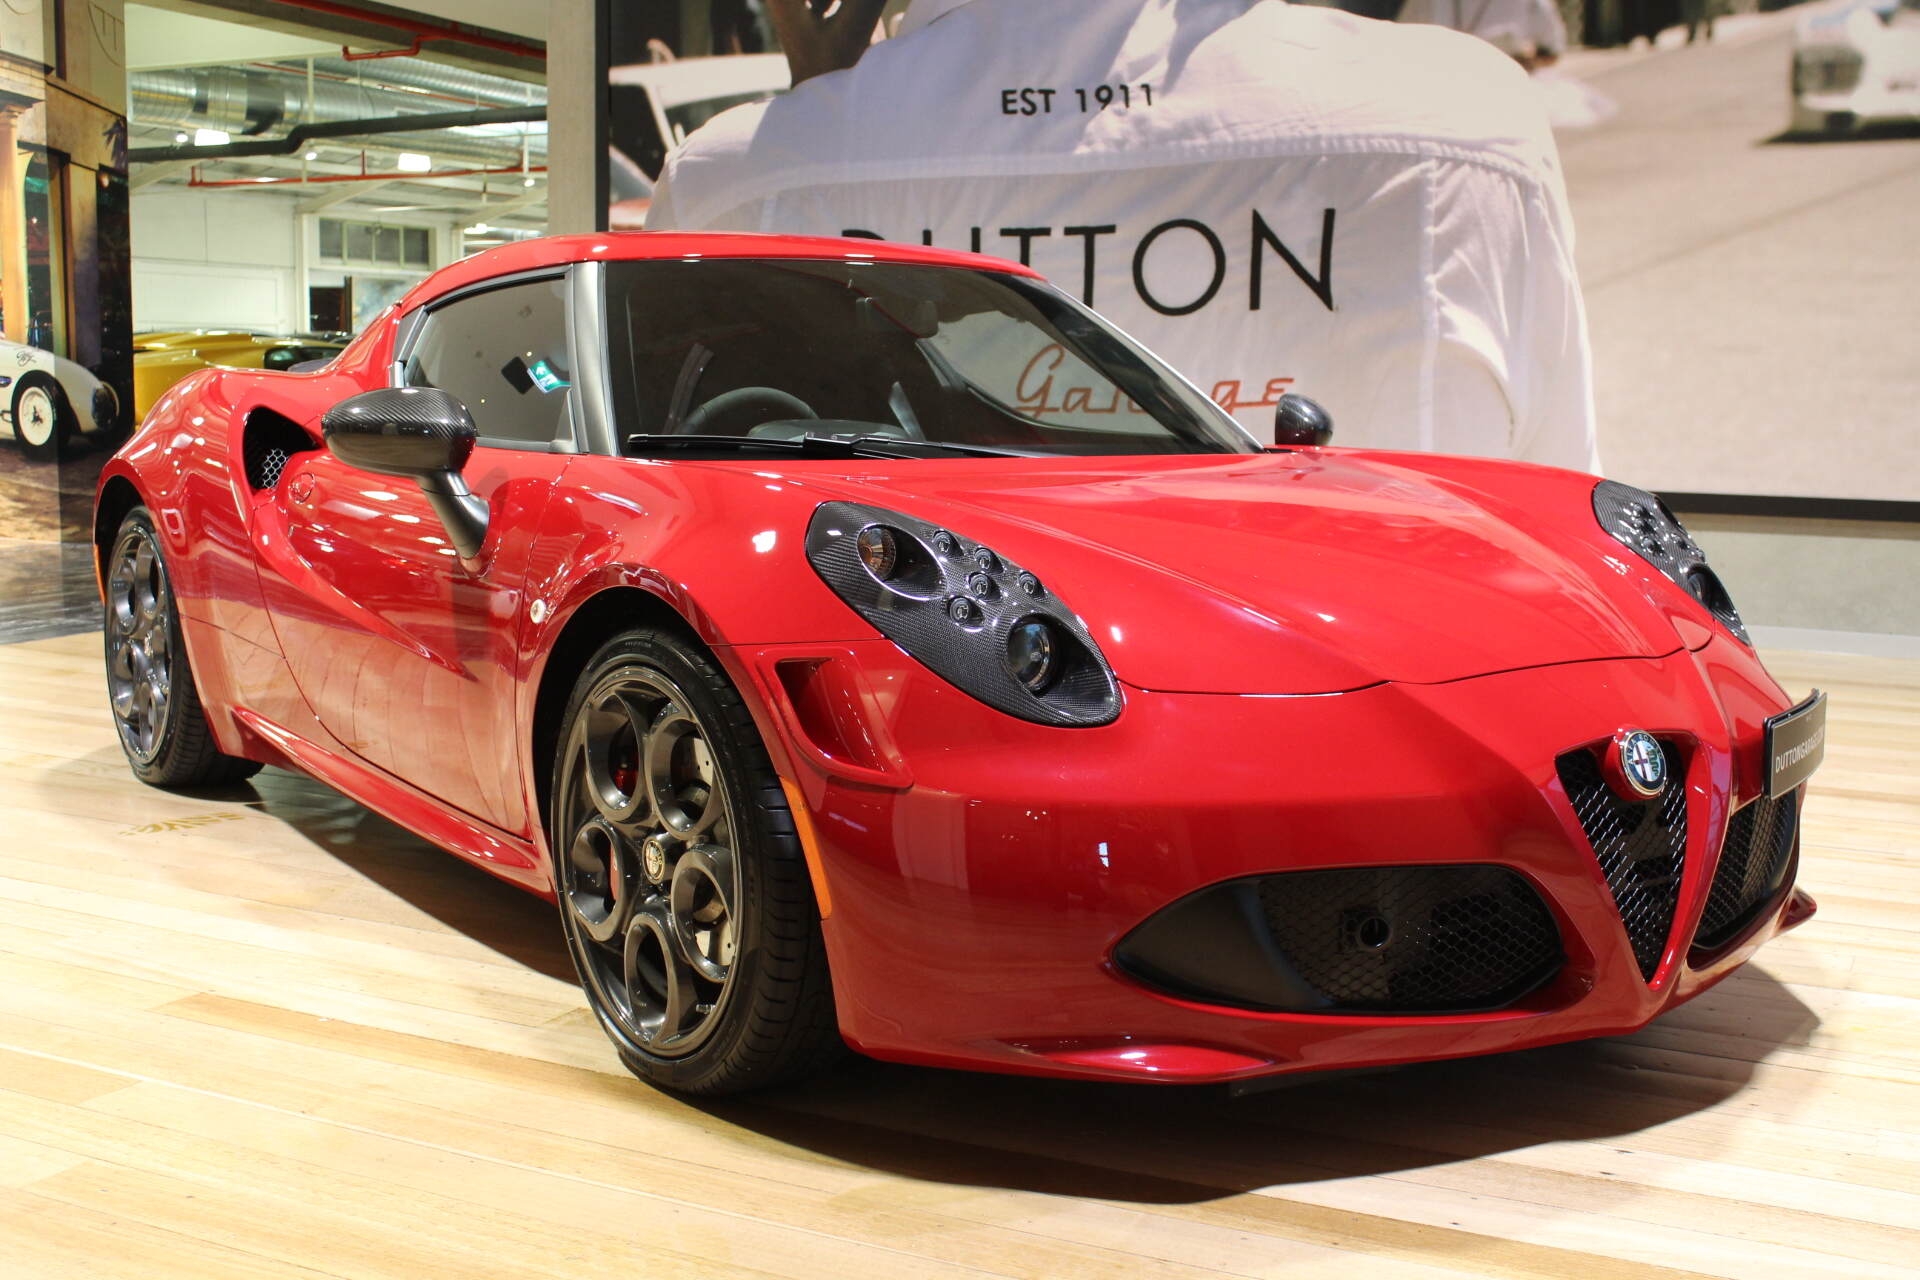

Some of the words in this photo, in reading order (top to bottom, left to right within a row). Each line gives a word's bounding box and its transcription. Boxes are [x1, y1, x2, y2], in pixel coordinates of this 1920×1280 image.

[1001, 88, 1057, 116] EST
[1075, 83, 1152, 113] 1911
[841, 207, 1336, 317] TTON
[1015, 343, 1294, 418] Garge
